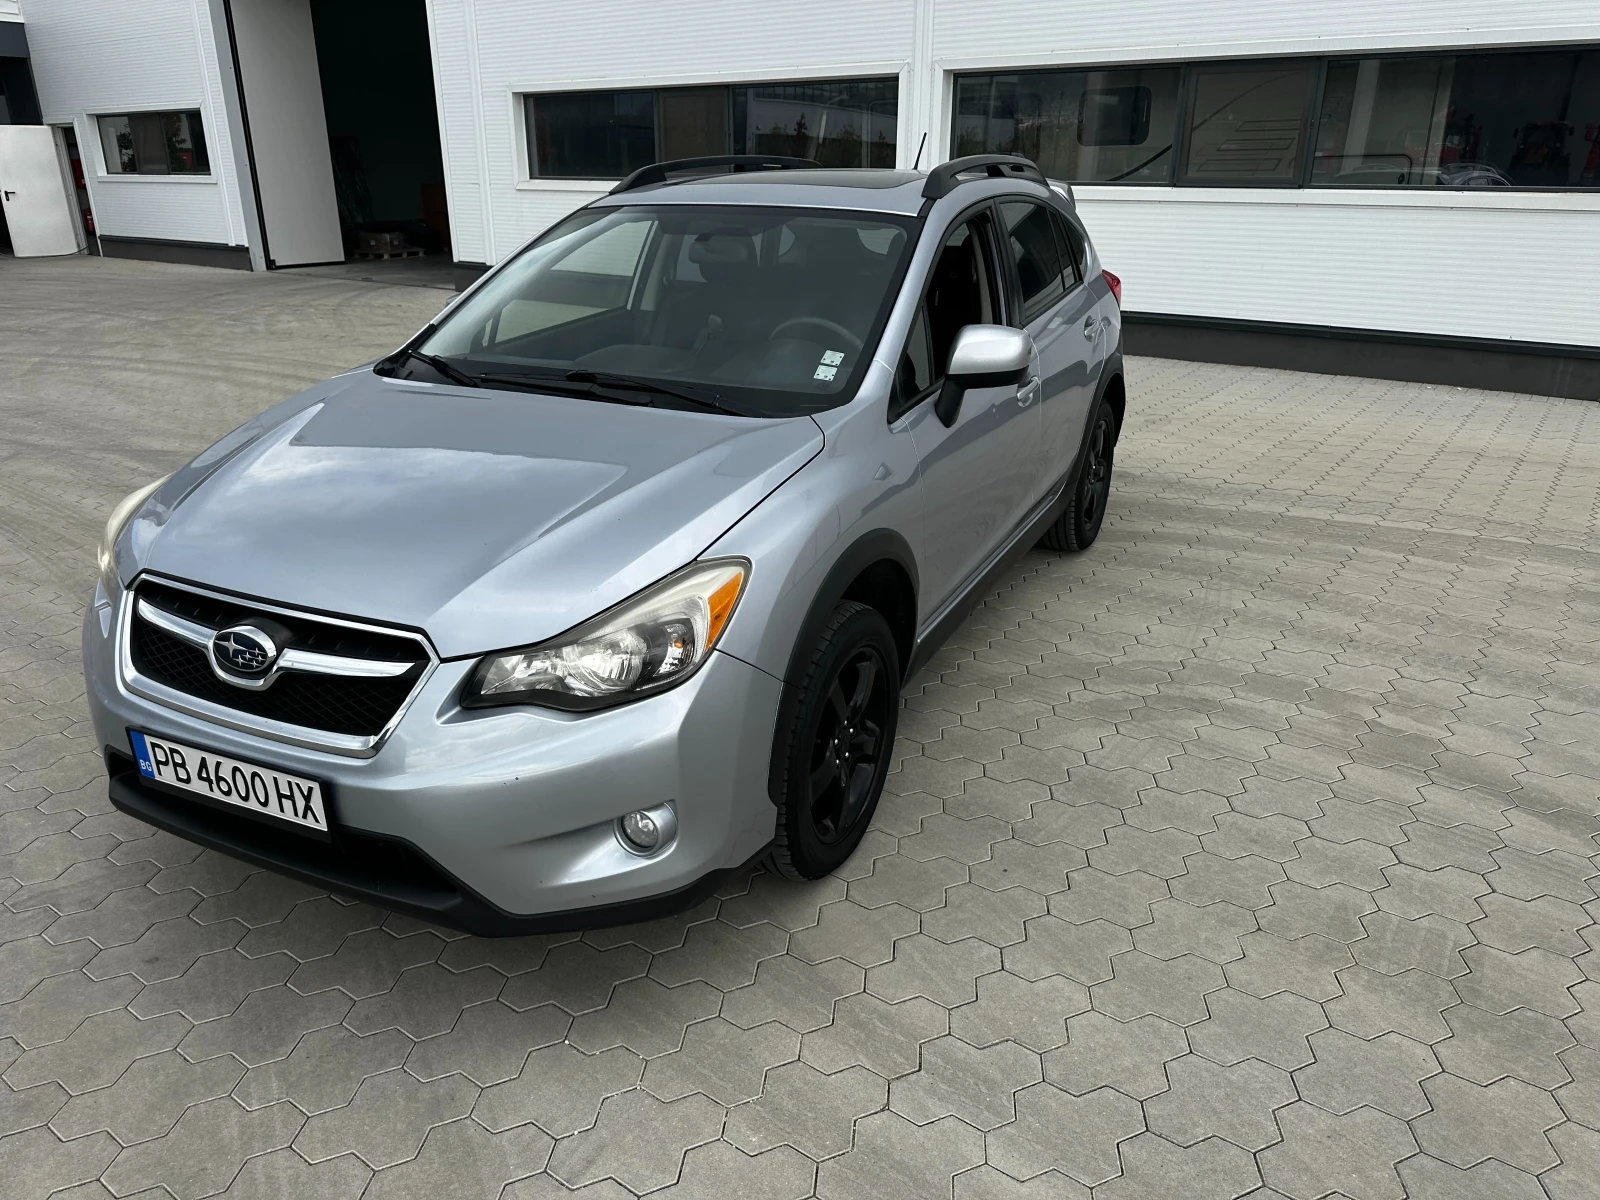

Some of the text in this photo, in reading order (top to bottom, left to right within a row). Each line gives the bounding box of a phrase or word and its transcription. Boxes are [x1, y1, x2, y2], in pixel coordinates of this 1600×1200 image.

[139, 759, 153, 772] BG
[150, 740, 321, 824] PB 4600 HX
